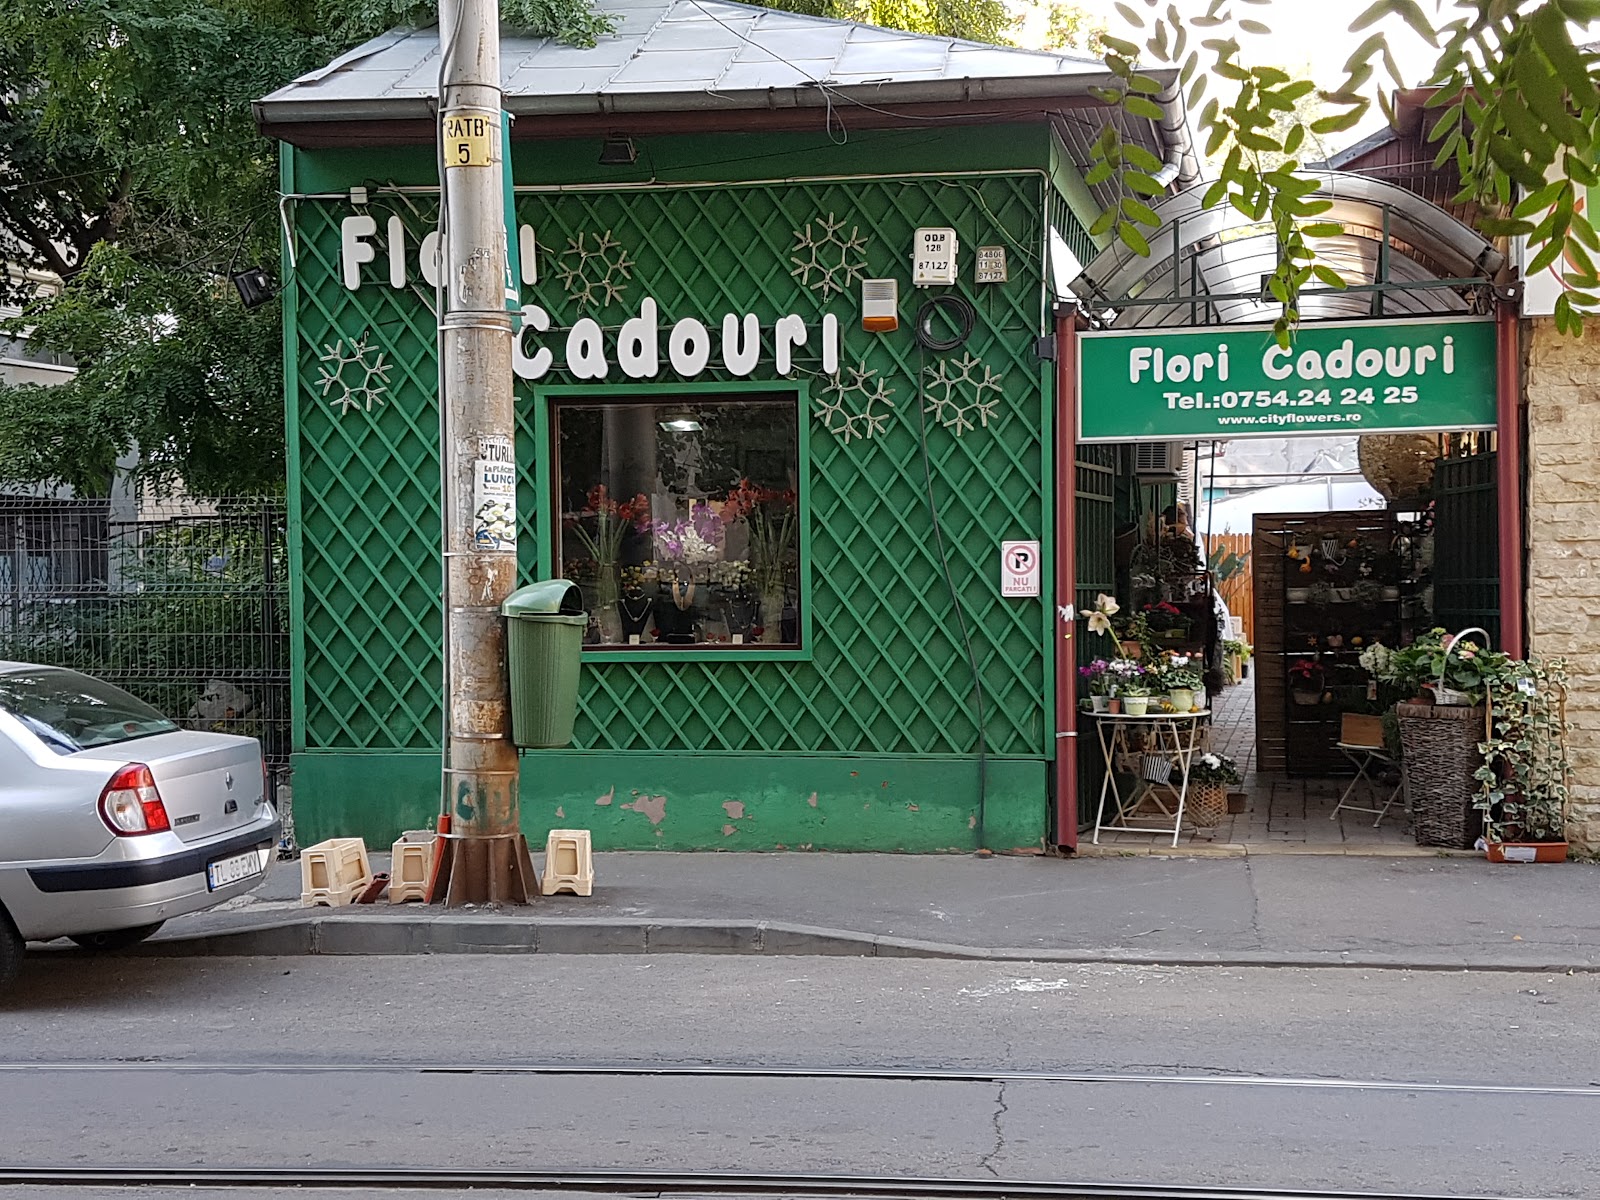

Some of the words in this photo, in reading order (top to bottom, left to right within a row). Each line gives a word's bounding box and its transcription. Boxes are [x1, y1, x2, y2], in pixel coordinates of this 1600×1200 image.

[446, 118, 484, 138] RATB
[458, 143, 470, 164] 5
[924, 233, 946, 242] ODB
[341, 215, 537, 290] Floi
[918, 261, 949, 270] 87127
[1129, 343, 1229, 384] Flori
[1261, 335, 1455, 381] Cadouri
[1162, 388, 1332, 410] Tel.:0754.24
[1339, 386, 1376, 406] 24
[1382, 385, 1420, 404] 25
[1217, 412, 1362, 426] www.cityflowers.ro
[1013, 577, 1029, 586] NU
